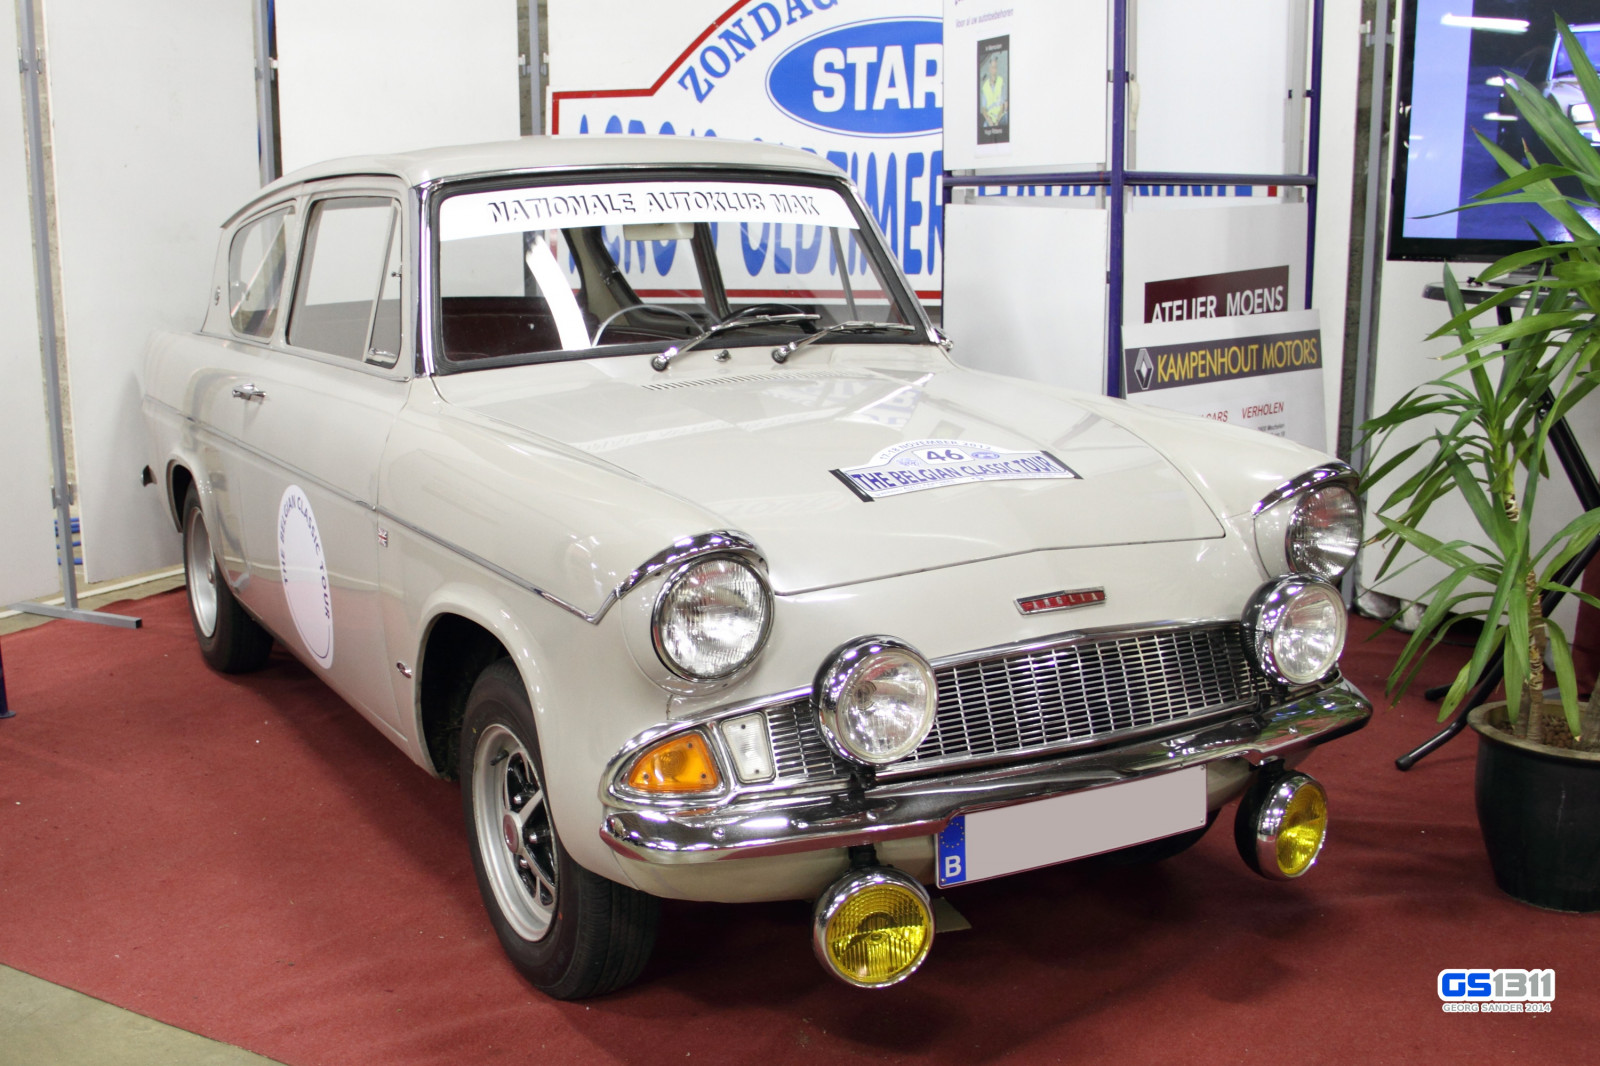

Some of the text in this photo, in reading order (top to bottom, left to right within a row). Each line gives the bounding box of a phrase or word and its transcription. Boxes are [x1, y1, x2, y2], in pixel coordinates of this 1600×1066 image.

[487, 191, 820, 223] NATIONALE AUTOKLUB MAK
[1152, 286, 1284, 323] ATELIER MOENS
[1157, 338, 1318, 383] KAMPENHOUT MOTORS
[1241, 402, 1284, 419] VERHOLEN
[927, 449, 964, 461] 46
[851, 472, 897, 490] THE
[888, 467, 963, 485] BELGIAN
[960, 461, 1022, 476] CLASSIC
[1012, 456, 1064, 472] TOUR
[945, 855, 962, 878] B
